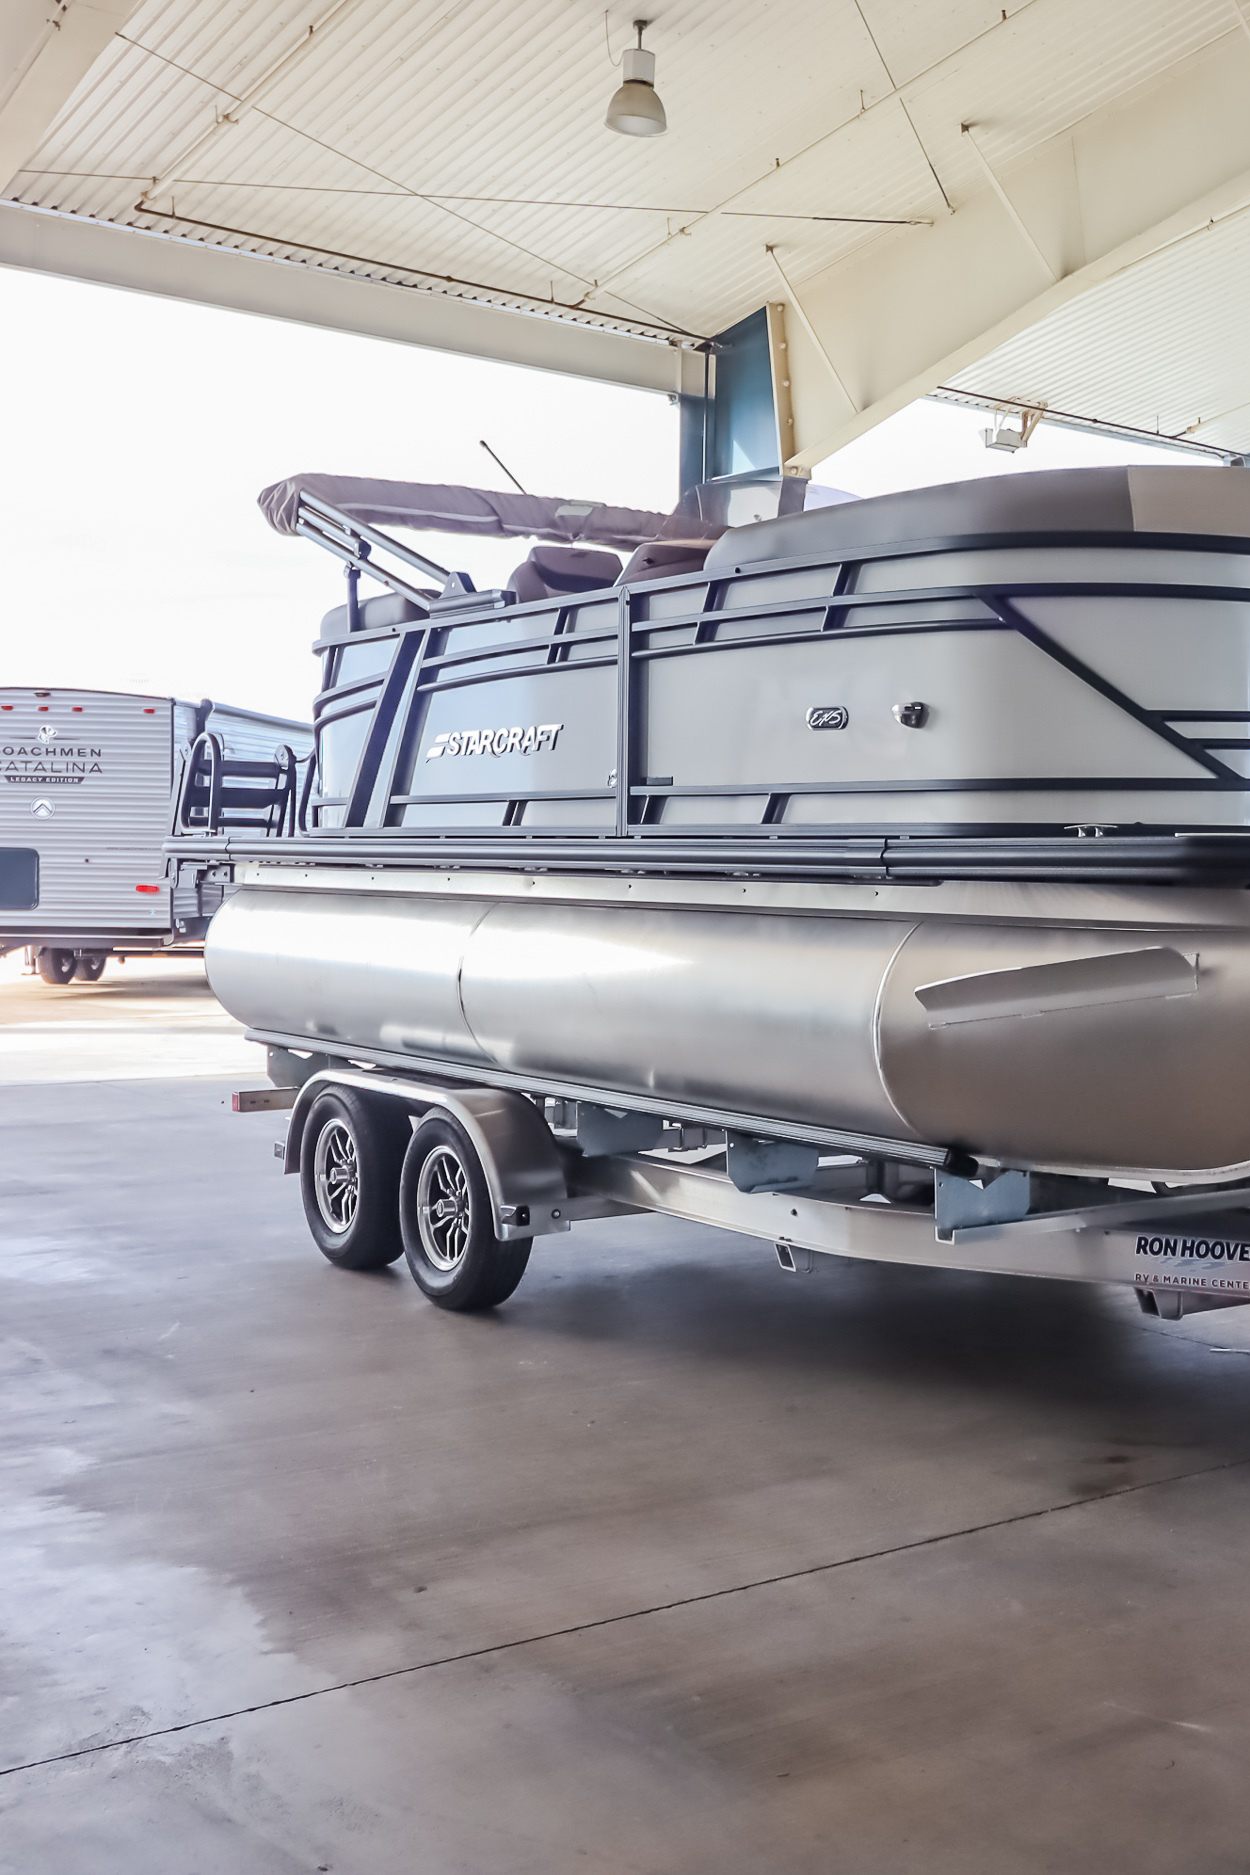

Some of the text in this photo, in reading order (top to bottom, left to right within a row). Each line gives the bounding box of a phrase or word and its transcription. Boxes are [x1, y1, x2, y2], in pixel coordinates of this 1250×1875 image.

[446, 723, 565, 758] STARCRAFT
[0, 746, 102, 758] OACHMEN
[0, 760, 103, 774] ATALINA
[1135, 1236, 1178, 1257] RON
[1135, 1273, 1150, 1282] RV
[1152, 1275, 1160, 1283] &
[1163, 1275, 1207, 1287] MARINE
